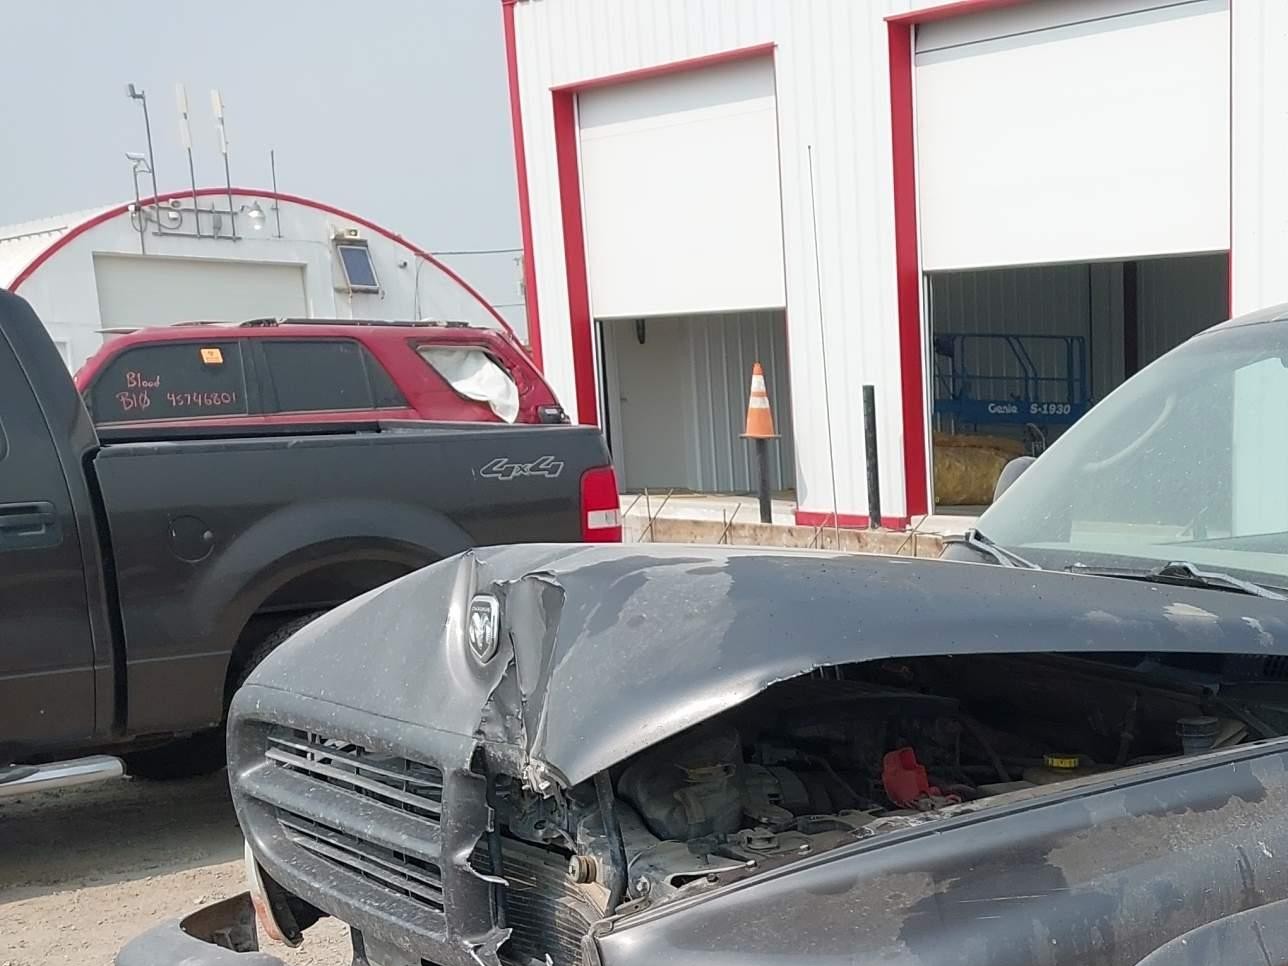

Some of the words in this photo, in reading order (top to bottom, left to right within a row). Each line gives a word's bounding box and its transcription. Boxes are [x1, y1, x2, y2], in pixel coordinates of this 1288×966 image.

[126, 371, 160, 388] Blood
[167, 392, 237, 407] 45746801
[988, 403, 1018, 414] Genie
[1030, 403, 1071, 414] S-1930
[480, 455, 564, 480] 4x4
